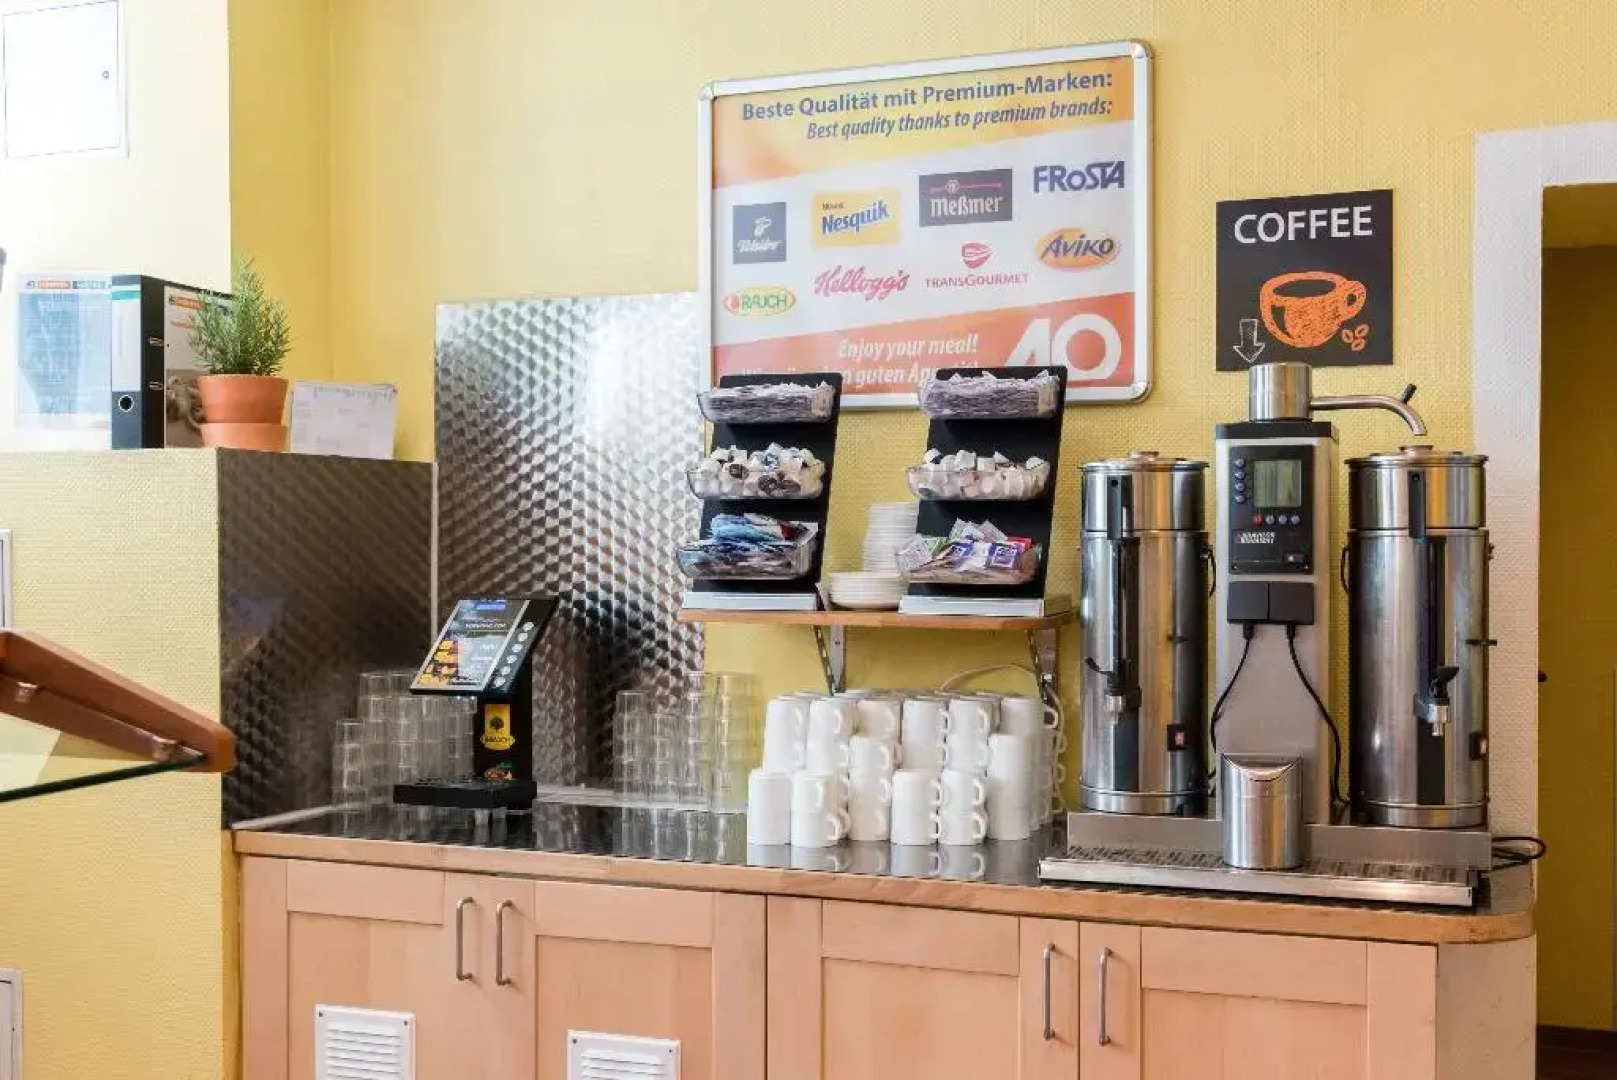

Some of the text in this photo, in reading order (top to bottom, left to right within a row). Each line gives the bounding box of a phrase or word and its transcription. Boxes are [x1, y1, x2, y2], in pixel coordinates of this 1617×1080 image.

[742, 72, 1112, 120] Beste Qualität mit Premium-Marken:
[807, 96, 1113, 142] Best quality thanks to premium brands:
[821, 200, 890, 236] Nesquik
[1234, 205, 1373, 243] COFFEE
[814, 264, 911, 301] Kellogg's
[741, 294, 787, 310] RAUCH
[838, 333, 979, 363] Enjoy your meal!
[855, 367, 904, 387] guten
